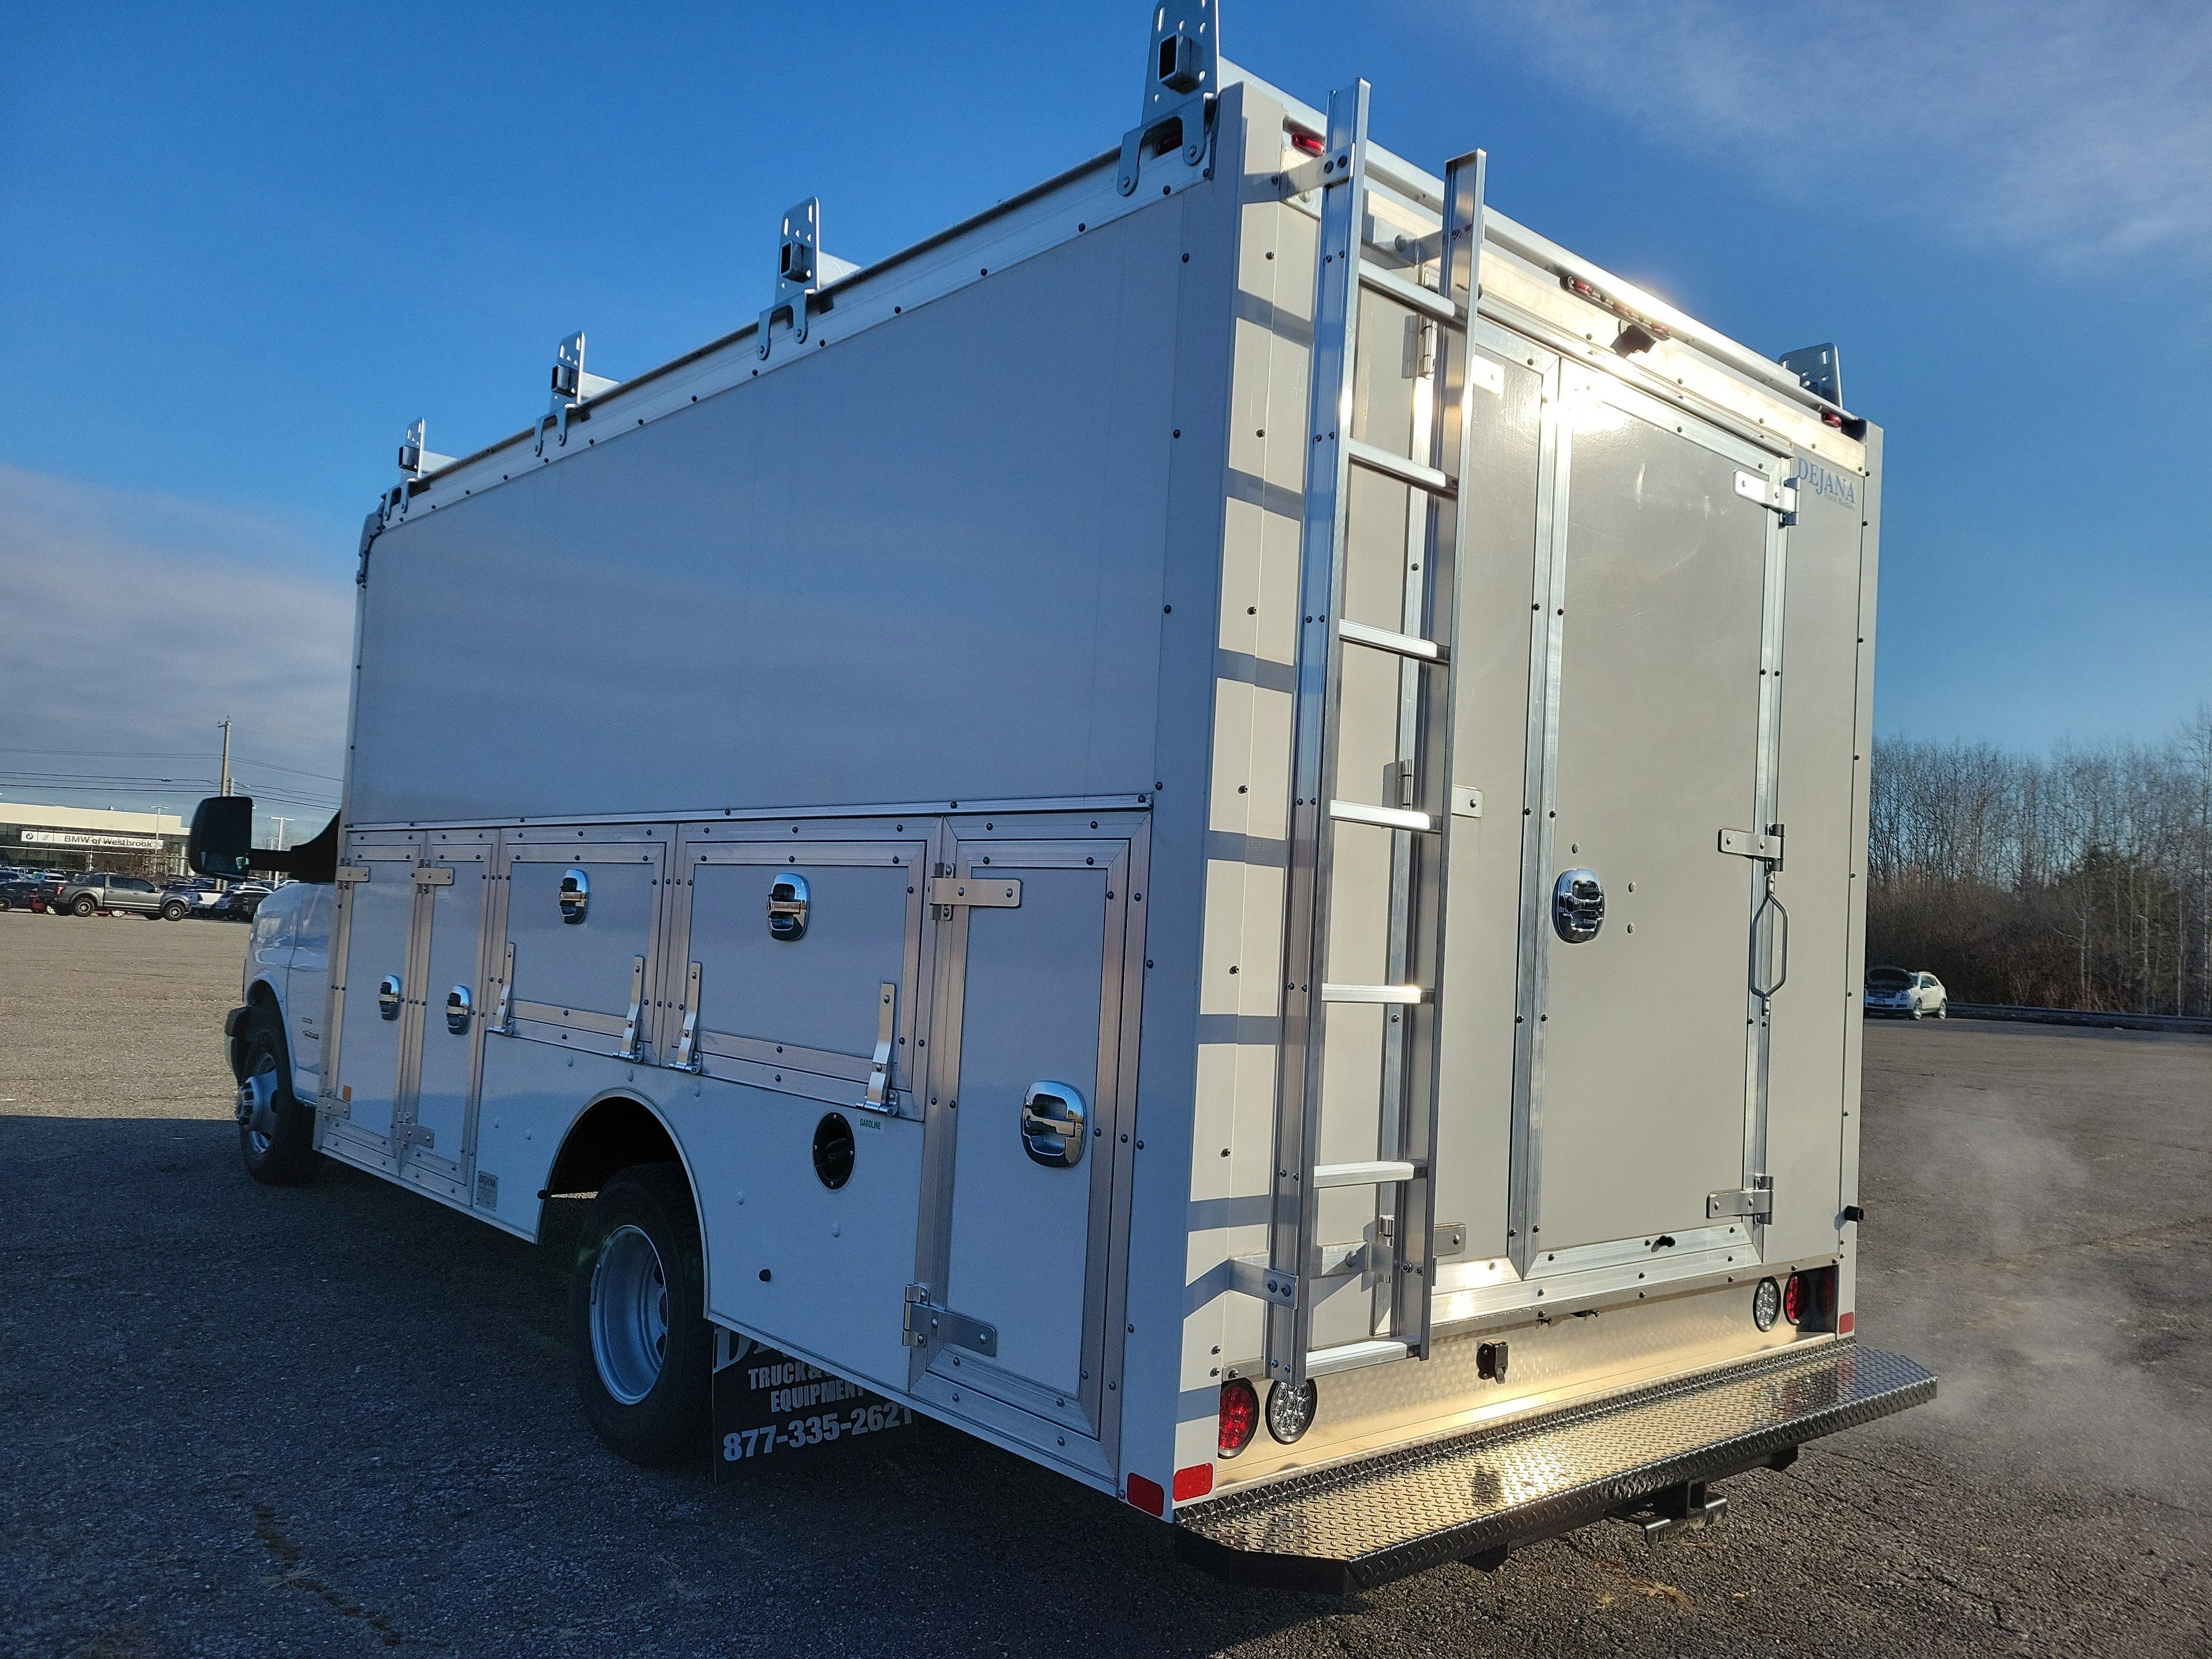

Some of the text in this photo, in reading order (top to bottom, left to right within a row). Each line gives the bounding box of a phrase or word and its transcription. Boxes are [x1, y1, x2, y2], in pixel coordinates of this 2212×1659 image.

[1797, 458, 1855, 503] DEJANA
[104, 838, 153, 848] Westbrook
[860, 1118, 881, 1130] GASOLINE
[748, 1361, 806, 1390] TRUCK
[724, 1402, 912, 1461] 877-335-2621
